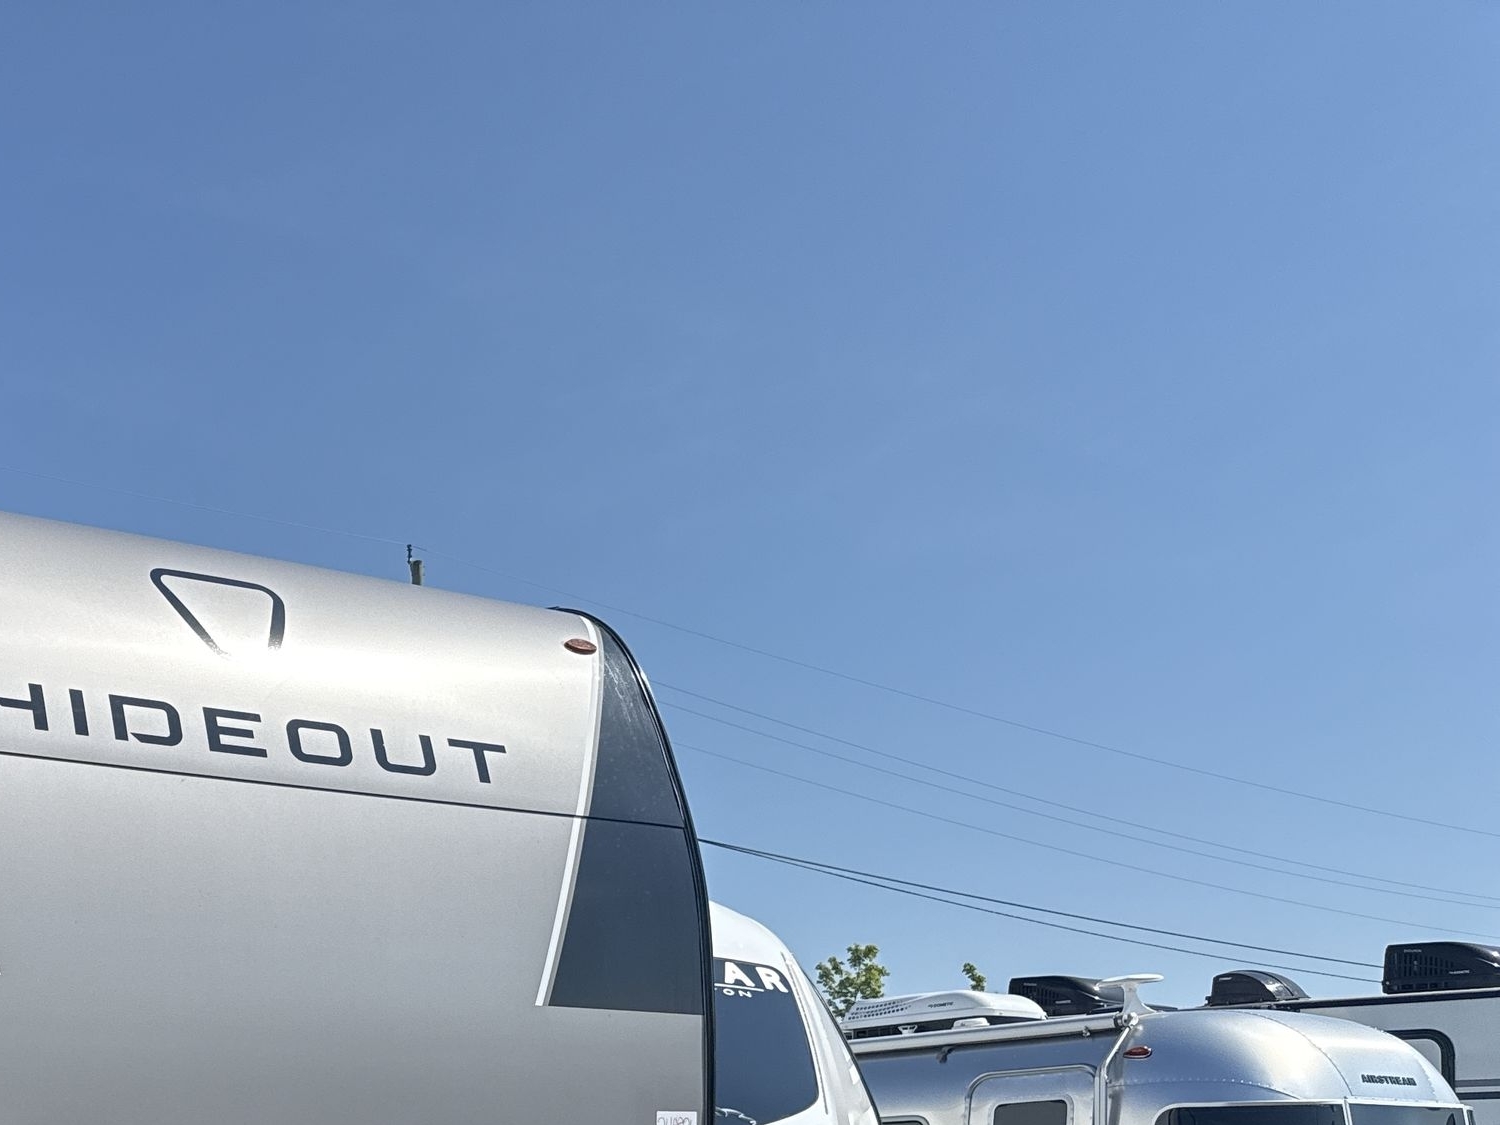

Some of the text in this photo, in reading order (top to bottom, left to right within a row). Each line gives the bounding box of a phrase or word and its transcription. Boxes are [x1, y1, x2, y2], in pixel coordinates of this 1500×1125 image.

[724, 961, 789, 994] AR
[714, 987, 753, 998] ON
[1361, 1074, 1417, 1086] AIRSTREAM
